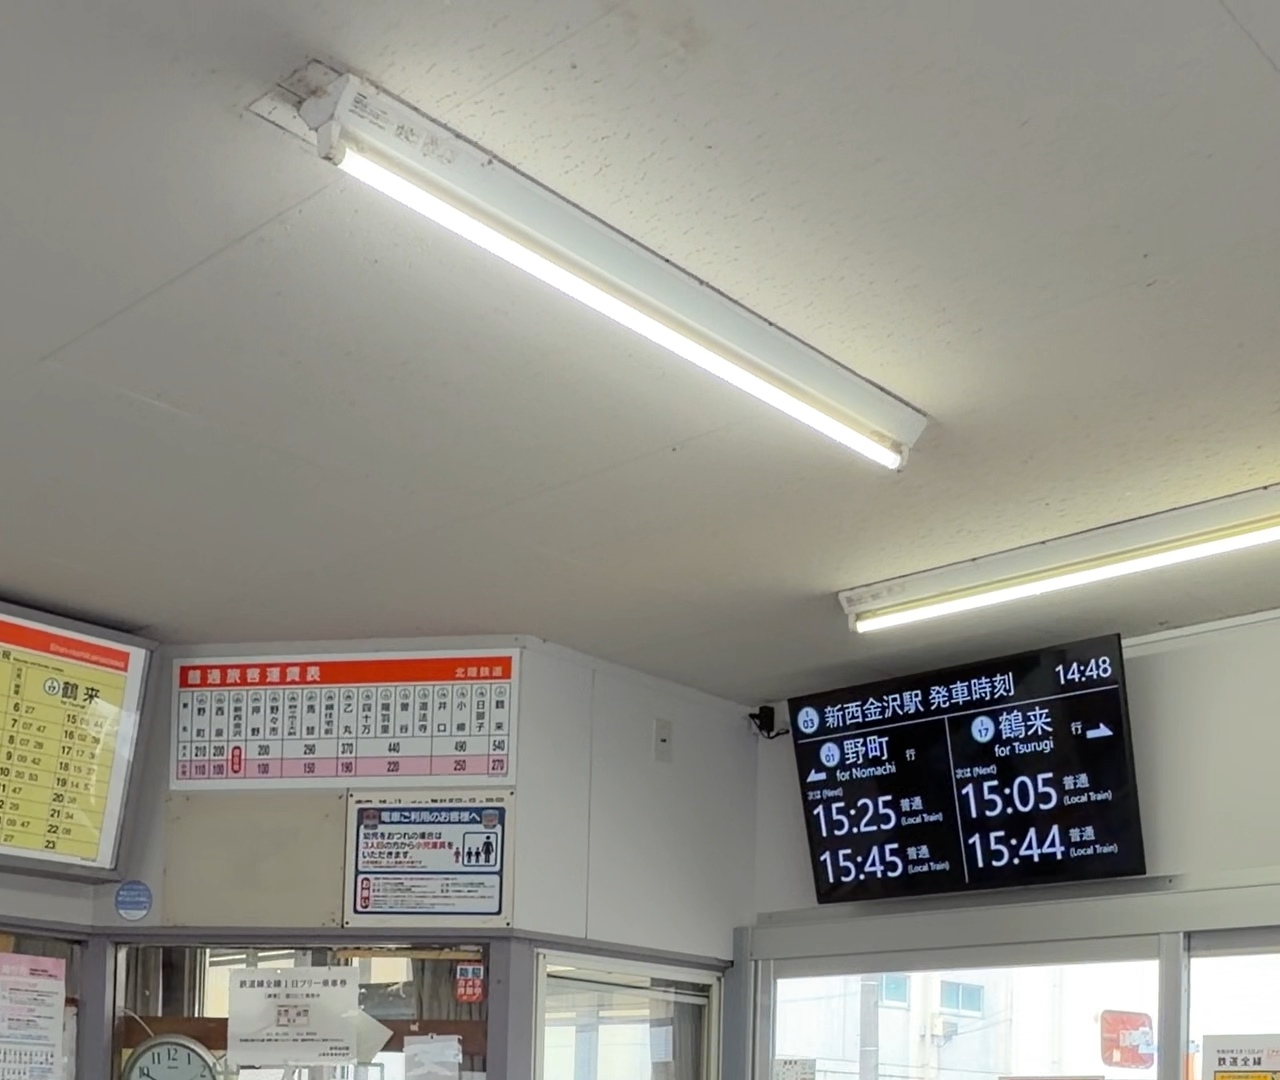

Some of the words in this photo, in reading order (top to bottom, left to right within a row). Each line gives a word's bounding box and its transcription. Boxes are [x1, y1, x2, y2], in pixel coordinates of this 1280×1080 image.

[455, 666, 502, 678] 北陸鉄道
[1055, 656, 1112, 685] 14:48
[61, 681, 100, 705] 鶴来
[824, 690, 924, 728] 新西金沢駅
[929, 672, 1015, 710] 発車時刻
[343, 703, 353, 735] 乙丸
[803, 718, 814, 729] 03
[999, 706, 1053, 740] 鶴来
[1071, 721, 1082, 735] 行
[978, 728, 989, 738] 17
[303, 743, 316, 755] 290
[341, 743, 354, 755] 370
[387, 742, 400, 754] 440
[454, 740, 467, 752] 490
[492, 739, 505, 751] 540
[843, 735, 889, 765] 野町
[906, 749, 916, 761] 行
[995, 745, 1010, 757] for
[1014, 737, 1054, 754] Tsurugi
[825, 753, 836, 763] 01
[194, 764, 206, 775] 110
[213, 763, 225, 775] 100
[257, 763, 269, 774] 100
[303, 762, 316, 774] 150
[341, 761, 353, 773] 190
[387, 761, 399, 773] 220
[453, 760, 466, 771] 250
[491, 759, 504, 771] 270
[836, 769, 850, 782] for
[852, 763, 896, 779] Nomachi
[972, 764, 997, 776] (Next)
[822, 788, 843, 800] (Next)
[961, 772, 1058, 819] 15:05
[1063, 773, 1089, 790] 普通
[1063, 793, 1087, 806] (Local
[1089, 789, 1112, 801] Train)
[381, 811, 480, 823] 電車ご利用のお客様へ
[812, 795, 897, 838] 15:25
[900, 796, 923, 812] 普通
[901, 816, 922, 826] (Local
[923, 812, 943, 822] Train)
[968, 824, 1065, 868] 15:44
[1069, 825, 1095, 842] 普通
[1070, 847, 1094, 857] (Local
[1095, 843, 1118, 854] Train)
[820, 843, 903, 883] 15:45
[907, 845, 930, 860] 普通
[908, 865, 928, 874] (Local
[930, 861, 950, 871] Train)
[152, 1051, 161, 1065] 11
[167, 1048, 178, 1061] 12
[138, 1066, 150, 1079] 10
[200, 1065, 207, 1078] 2
